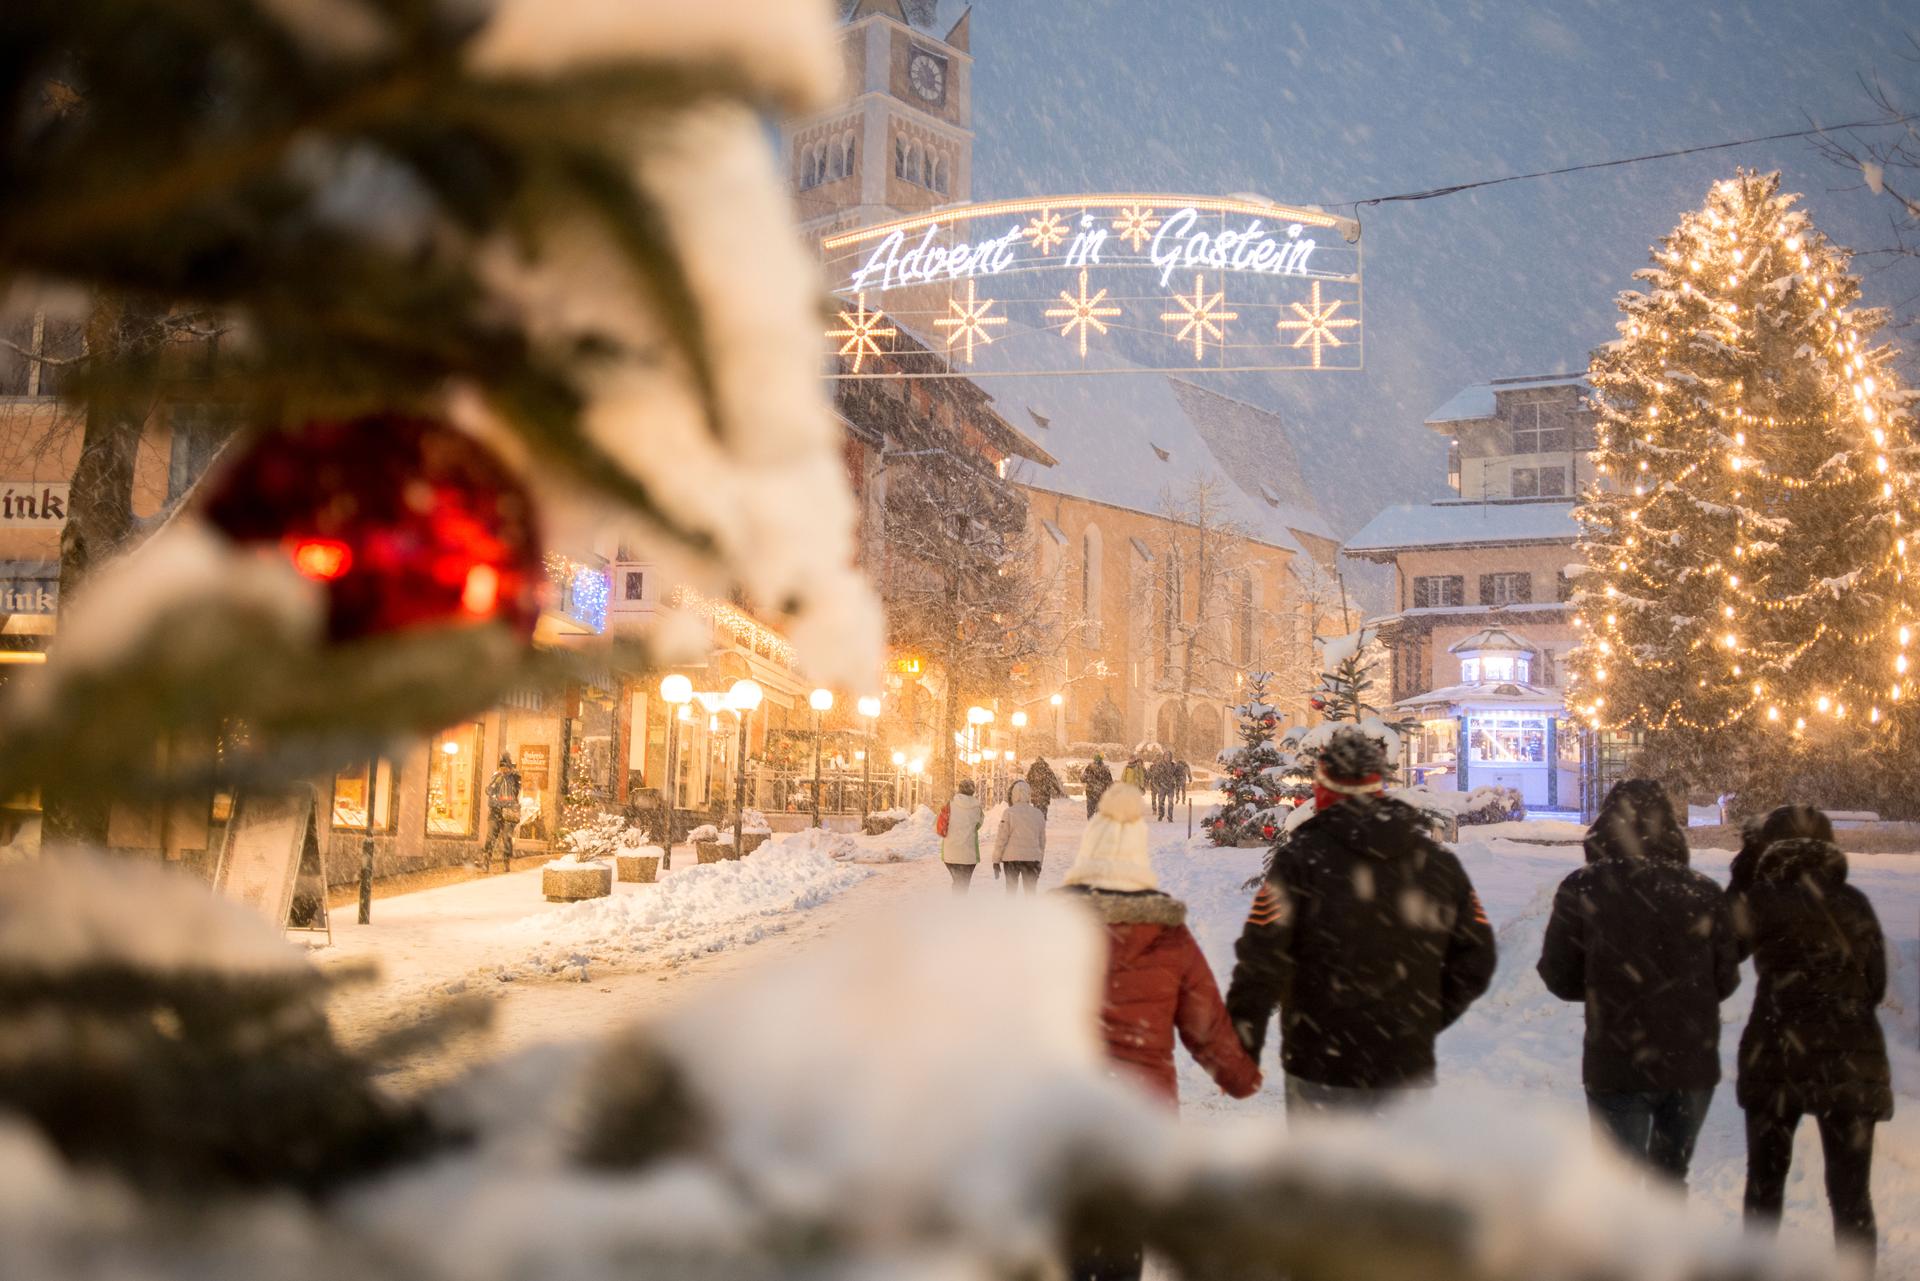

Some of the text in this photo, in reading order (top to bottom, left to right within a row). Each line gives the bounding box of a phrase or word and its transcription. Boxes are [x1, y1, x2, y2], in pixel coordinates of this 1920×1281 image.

[852, 208, 1316, 291] Advent in Gastein
[0, 587, 55, 611] ink
